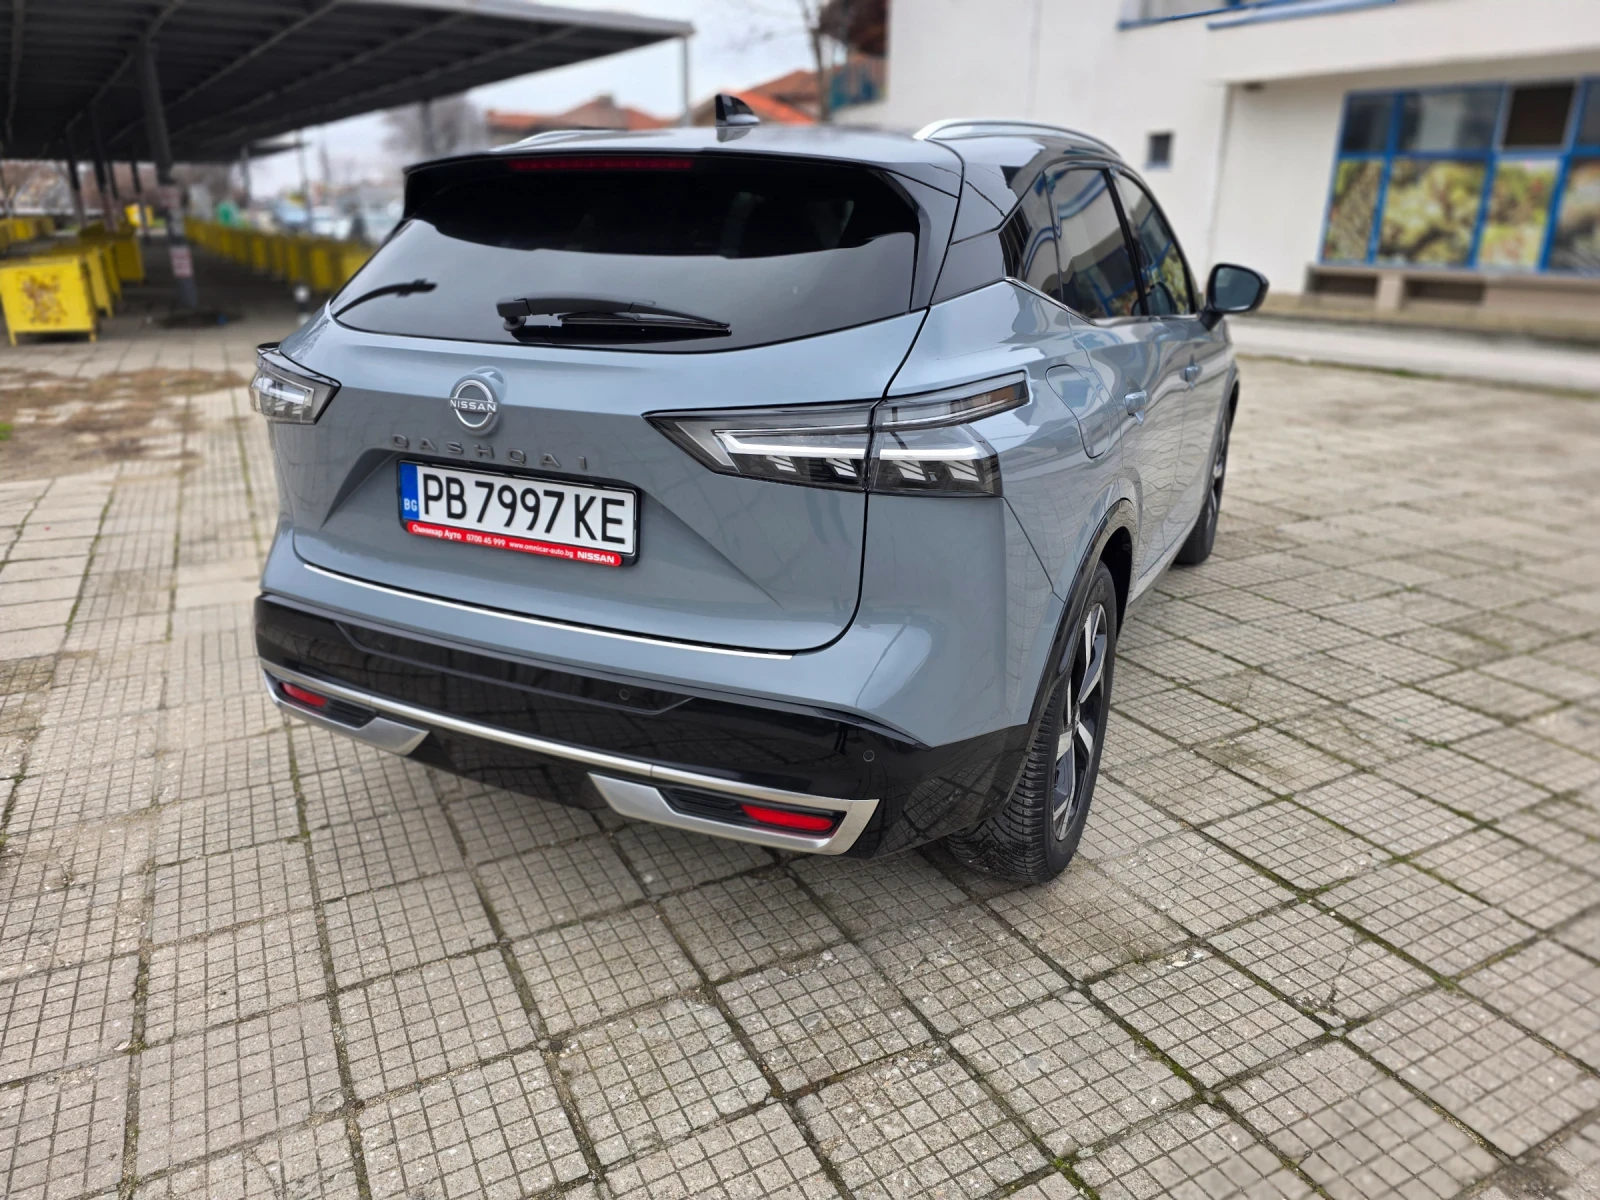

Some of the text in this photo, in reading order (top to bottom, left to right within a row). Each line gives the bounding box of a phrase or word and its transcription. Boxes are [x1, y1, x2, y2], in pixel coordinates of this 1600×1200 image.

[450, 399, 497, 412] NISSAN
[392, 434, 588, 471] QASHQAI
[404, 498, 418, 512] BG
[444, 529, 462, 540] Ауто
[466, 533, 506, 547] 0700 45 999
[509, 541, 574, 558] www.omnicar-auto.bg
[577, 550, 615, 564] NISSAN
